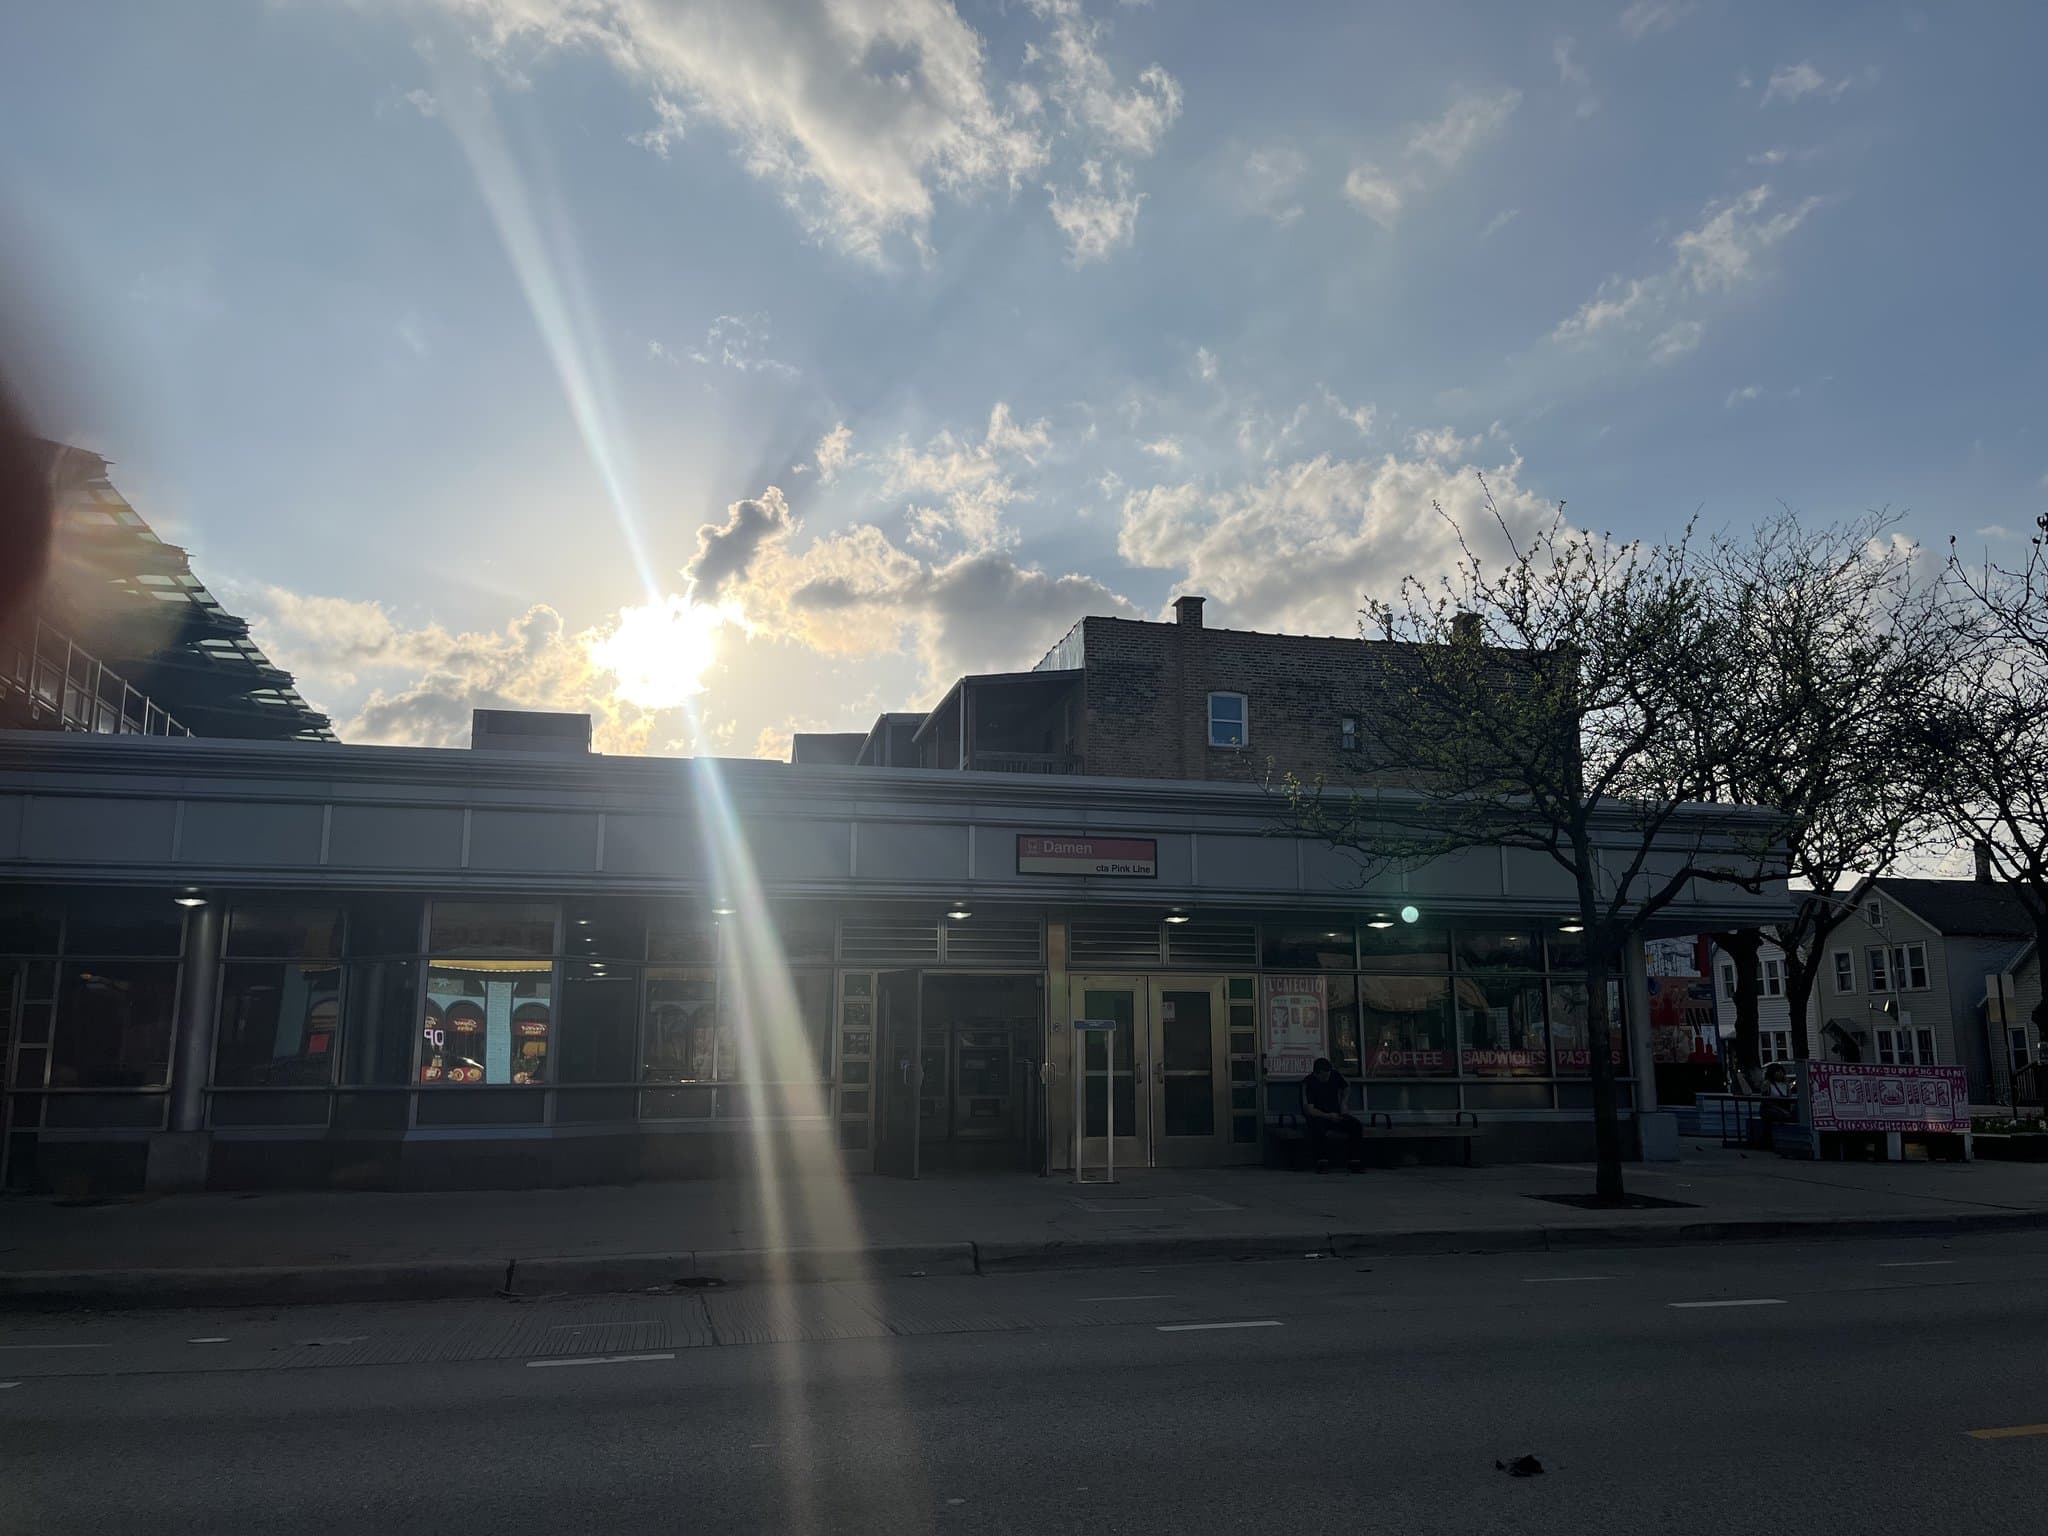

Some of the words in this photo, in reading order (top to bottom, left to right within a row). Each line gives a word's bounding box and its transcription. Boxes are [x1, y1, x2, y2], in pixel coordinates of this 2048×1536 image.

[1044, 840, 1093, 855] Damen
[1096, 864, 1109, 873] cta
[1112, 864, 1130, 873] Pink
[1133, 865, 1151, 874] Line
[1378, 1050, 1443, 1065] COFFEE
[1462, 1049, 1547, 1065] SANDWICHES
[1558, 1051, 1621, 1065] PASTS
[1876, 1121, 1918, 1131] CHICAGO
